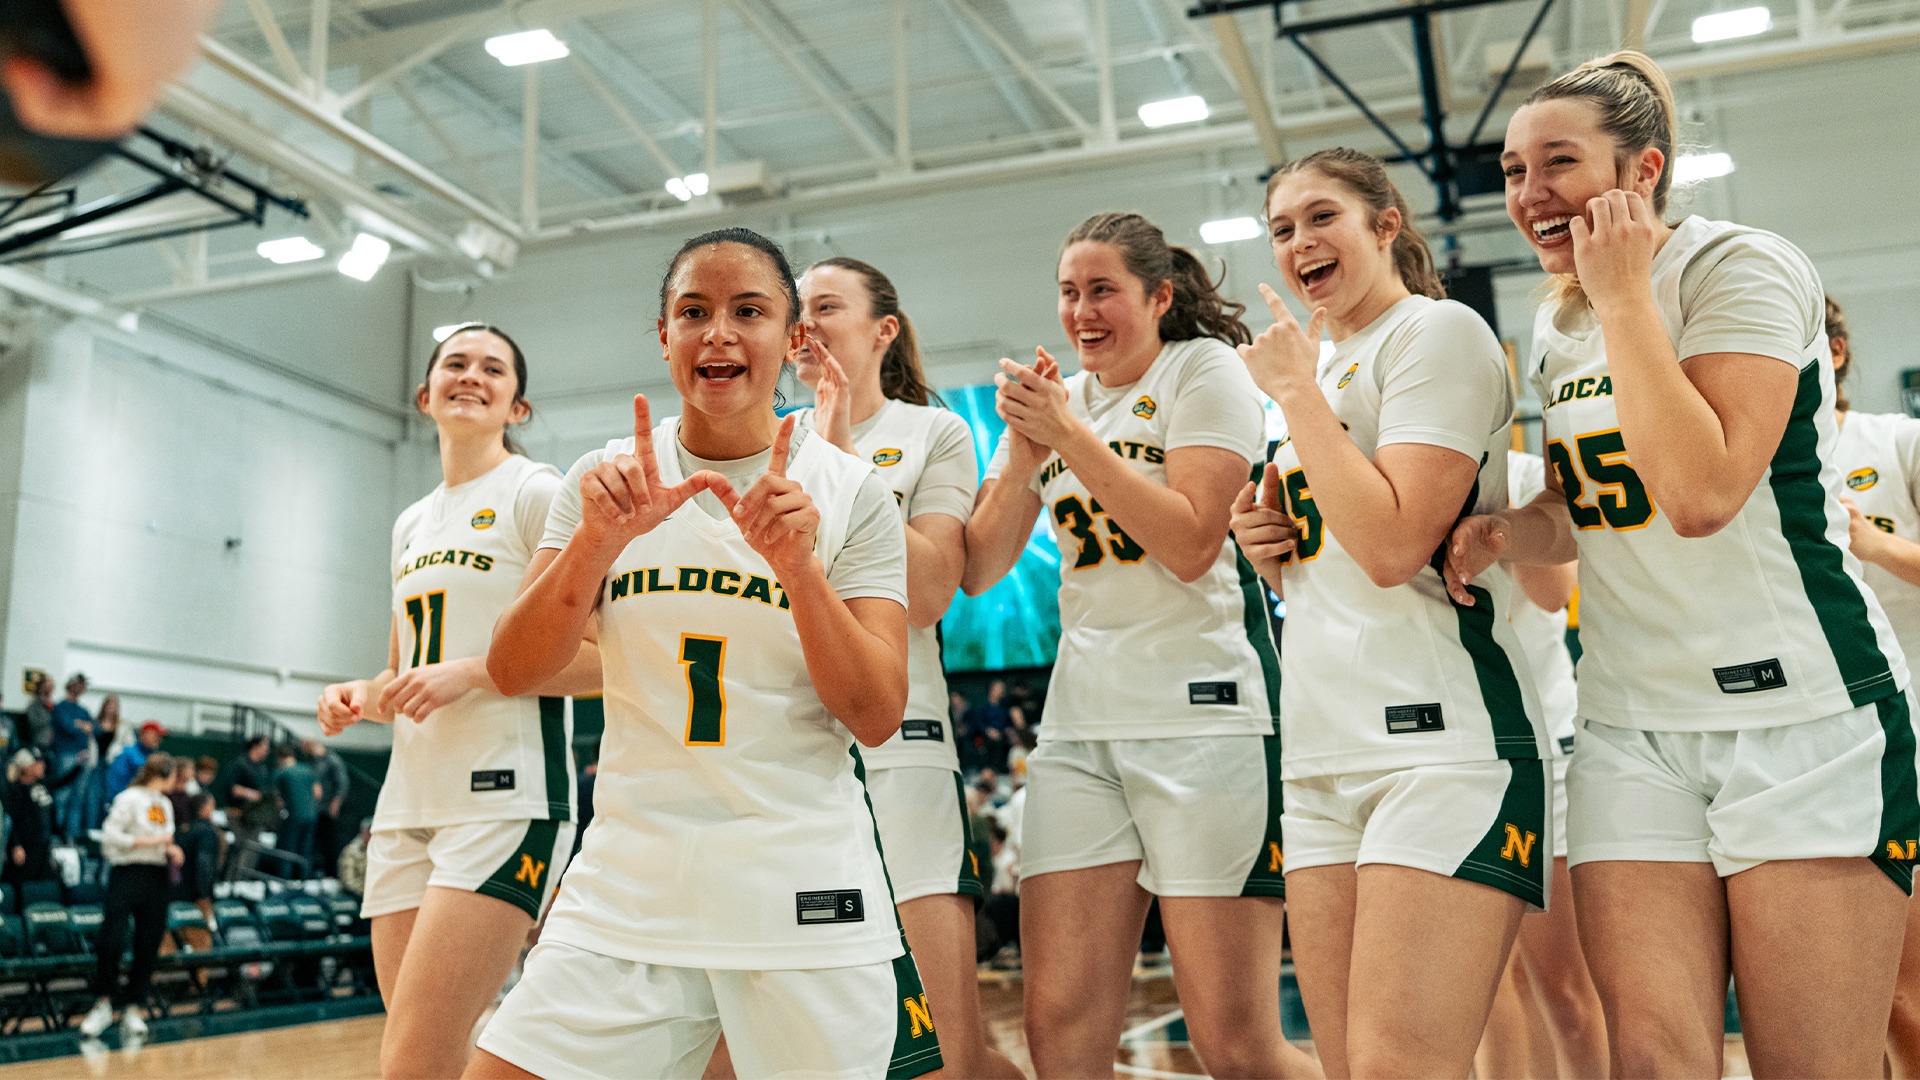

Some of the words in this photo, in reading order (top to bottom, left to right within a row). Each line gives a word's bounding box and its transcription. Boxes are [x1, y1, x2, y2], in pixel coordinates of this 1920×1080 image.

[1543, 374, 1613, 410] LDCA
[1040, 441, 1165, 488] WILATS
[1547, 428, 1658, 532] 25
[611, 566, 791, 613] WILDCAT
[405, 589, 447, 668] 11
[677, 632, 728, 747] 1
[1761, 668, 1775, 681] M
[1223, 688, 1230, 698] L
[931, 724, 940, 735] M
[1424, 712, 1432, 723] L
[500, 774, 510, 785] M
[1501, 822, 1537, 868] N
[1887, 839, 1917, 860] N
[515, 853, 546, 888] N
[845, 899, 854, 912] S
[903, 992, 935, 1039] N
